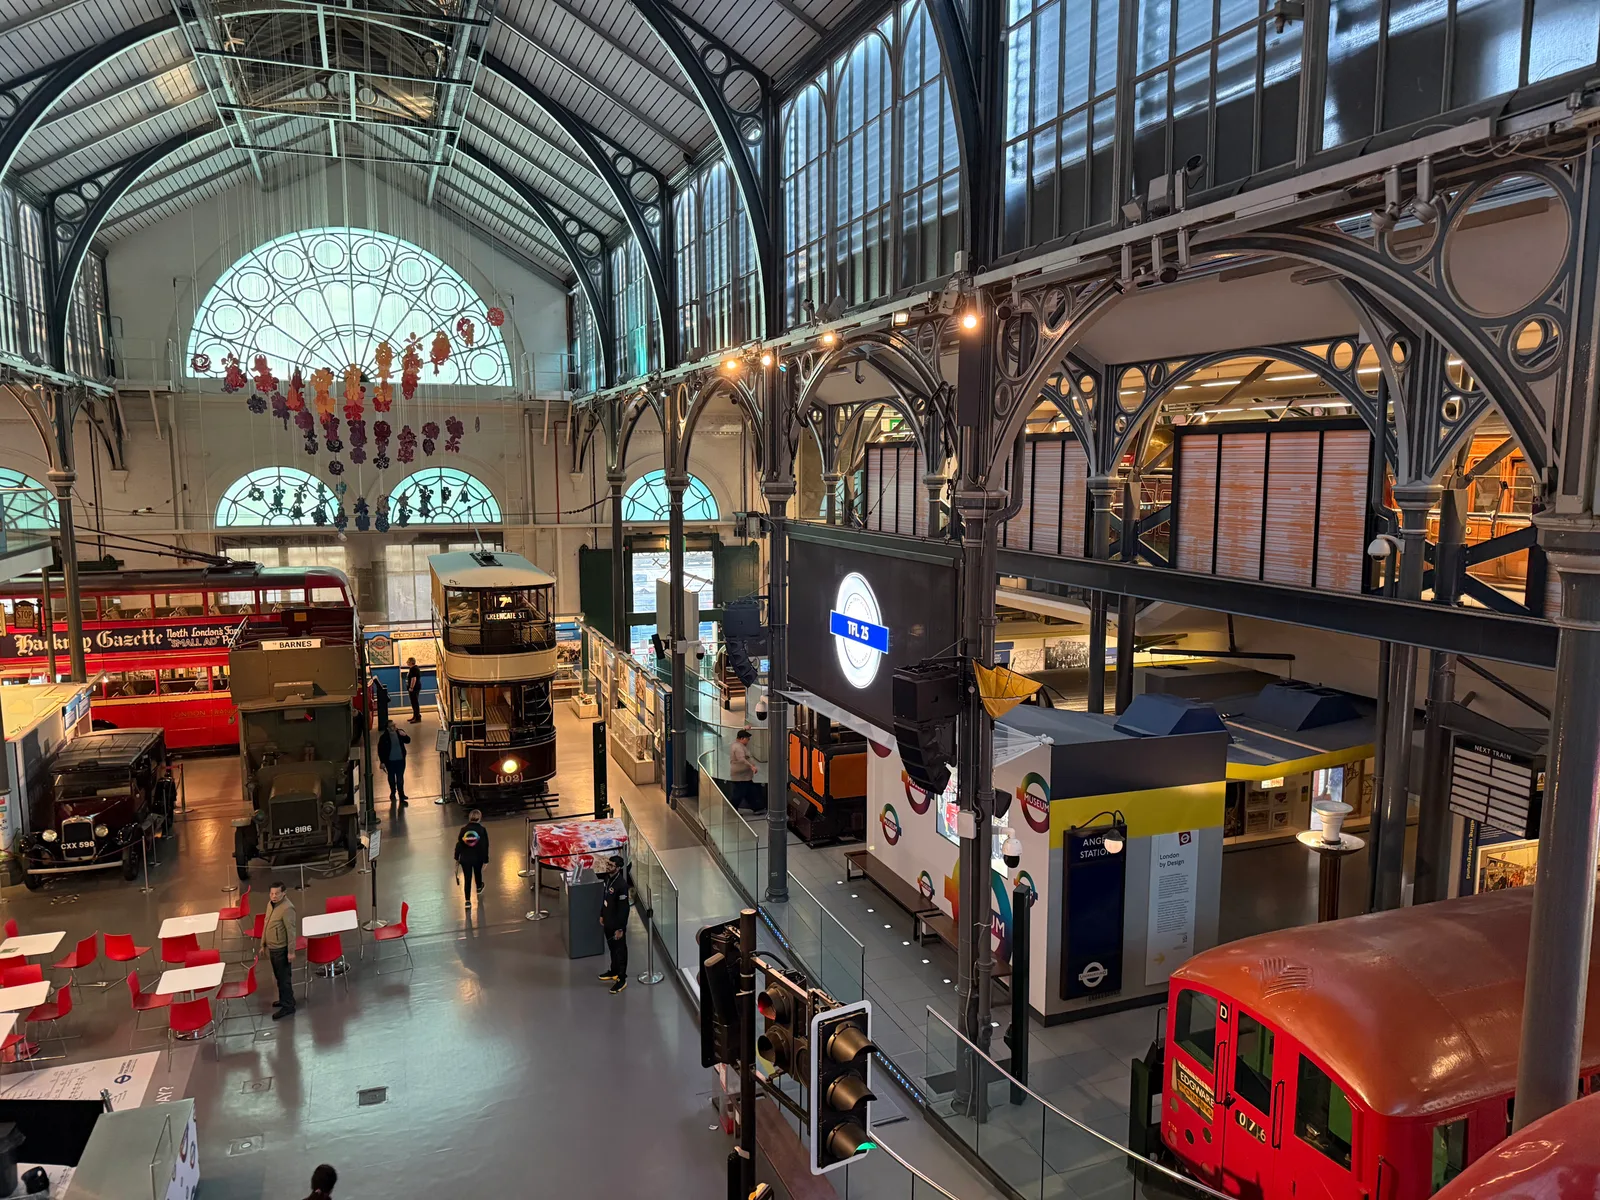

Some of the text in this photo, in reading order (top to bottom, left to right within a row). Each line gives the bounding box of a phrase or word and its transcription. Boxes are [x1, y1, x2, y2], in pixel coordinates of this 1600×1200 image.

[499, 595, 512, 608] 7A
[16, 609, 33, 619] STOP
[166, 628, 189, 638] North
[191, 626, 223, 637] London's
[847, 620, 870, 641] TFL 25
[96, 629, 163, 649] Gazette
[279, 641, 312, 649] BARNES
[1474, 745, 1512, 760] NEXT TRAIN
[1024, 793, 1050, 813] MUSEUM
[61, 842, 78, 850] CXX
[1167, 859, 1185, 867] Design
[1220, 1005, 1228, 1019] D
[1180, 1071, 1215, 1108] EDGWARE
[1239, 1112, 1267, 1142] 076
